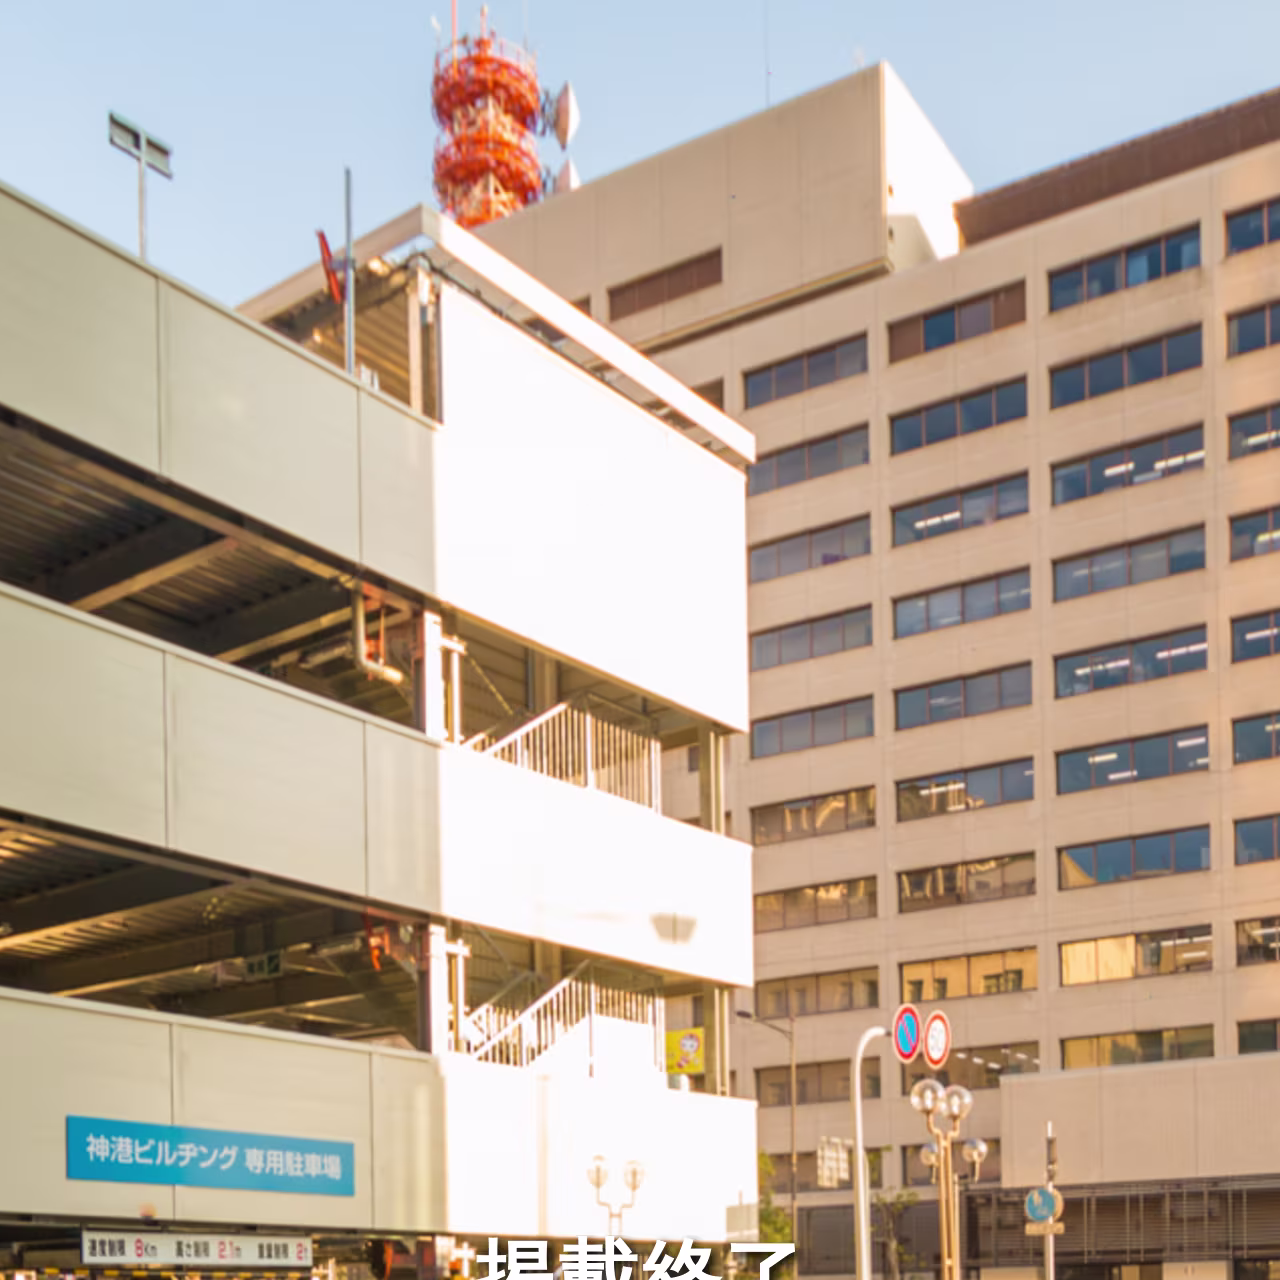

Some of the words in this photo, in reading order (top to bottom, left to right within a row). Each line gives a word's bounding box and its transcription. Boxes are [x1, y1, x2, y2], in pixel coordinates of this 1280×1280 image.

[245, 1148, 341, 1180] 専用駐車場
